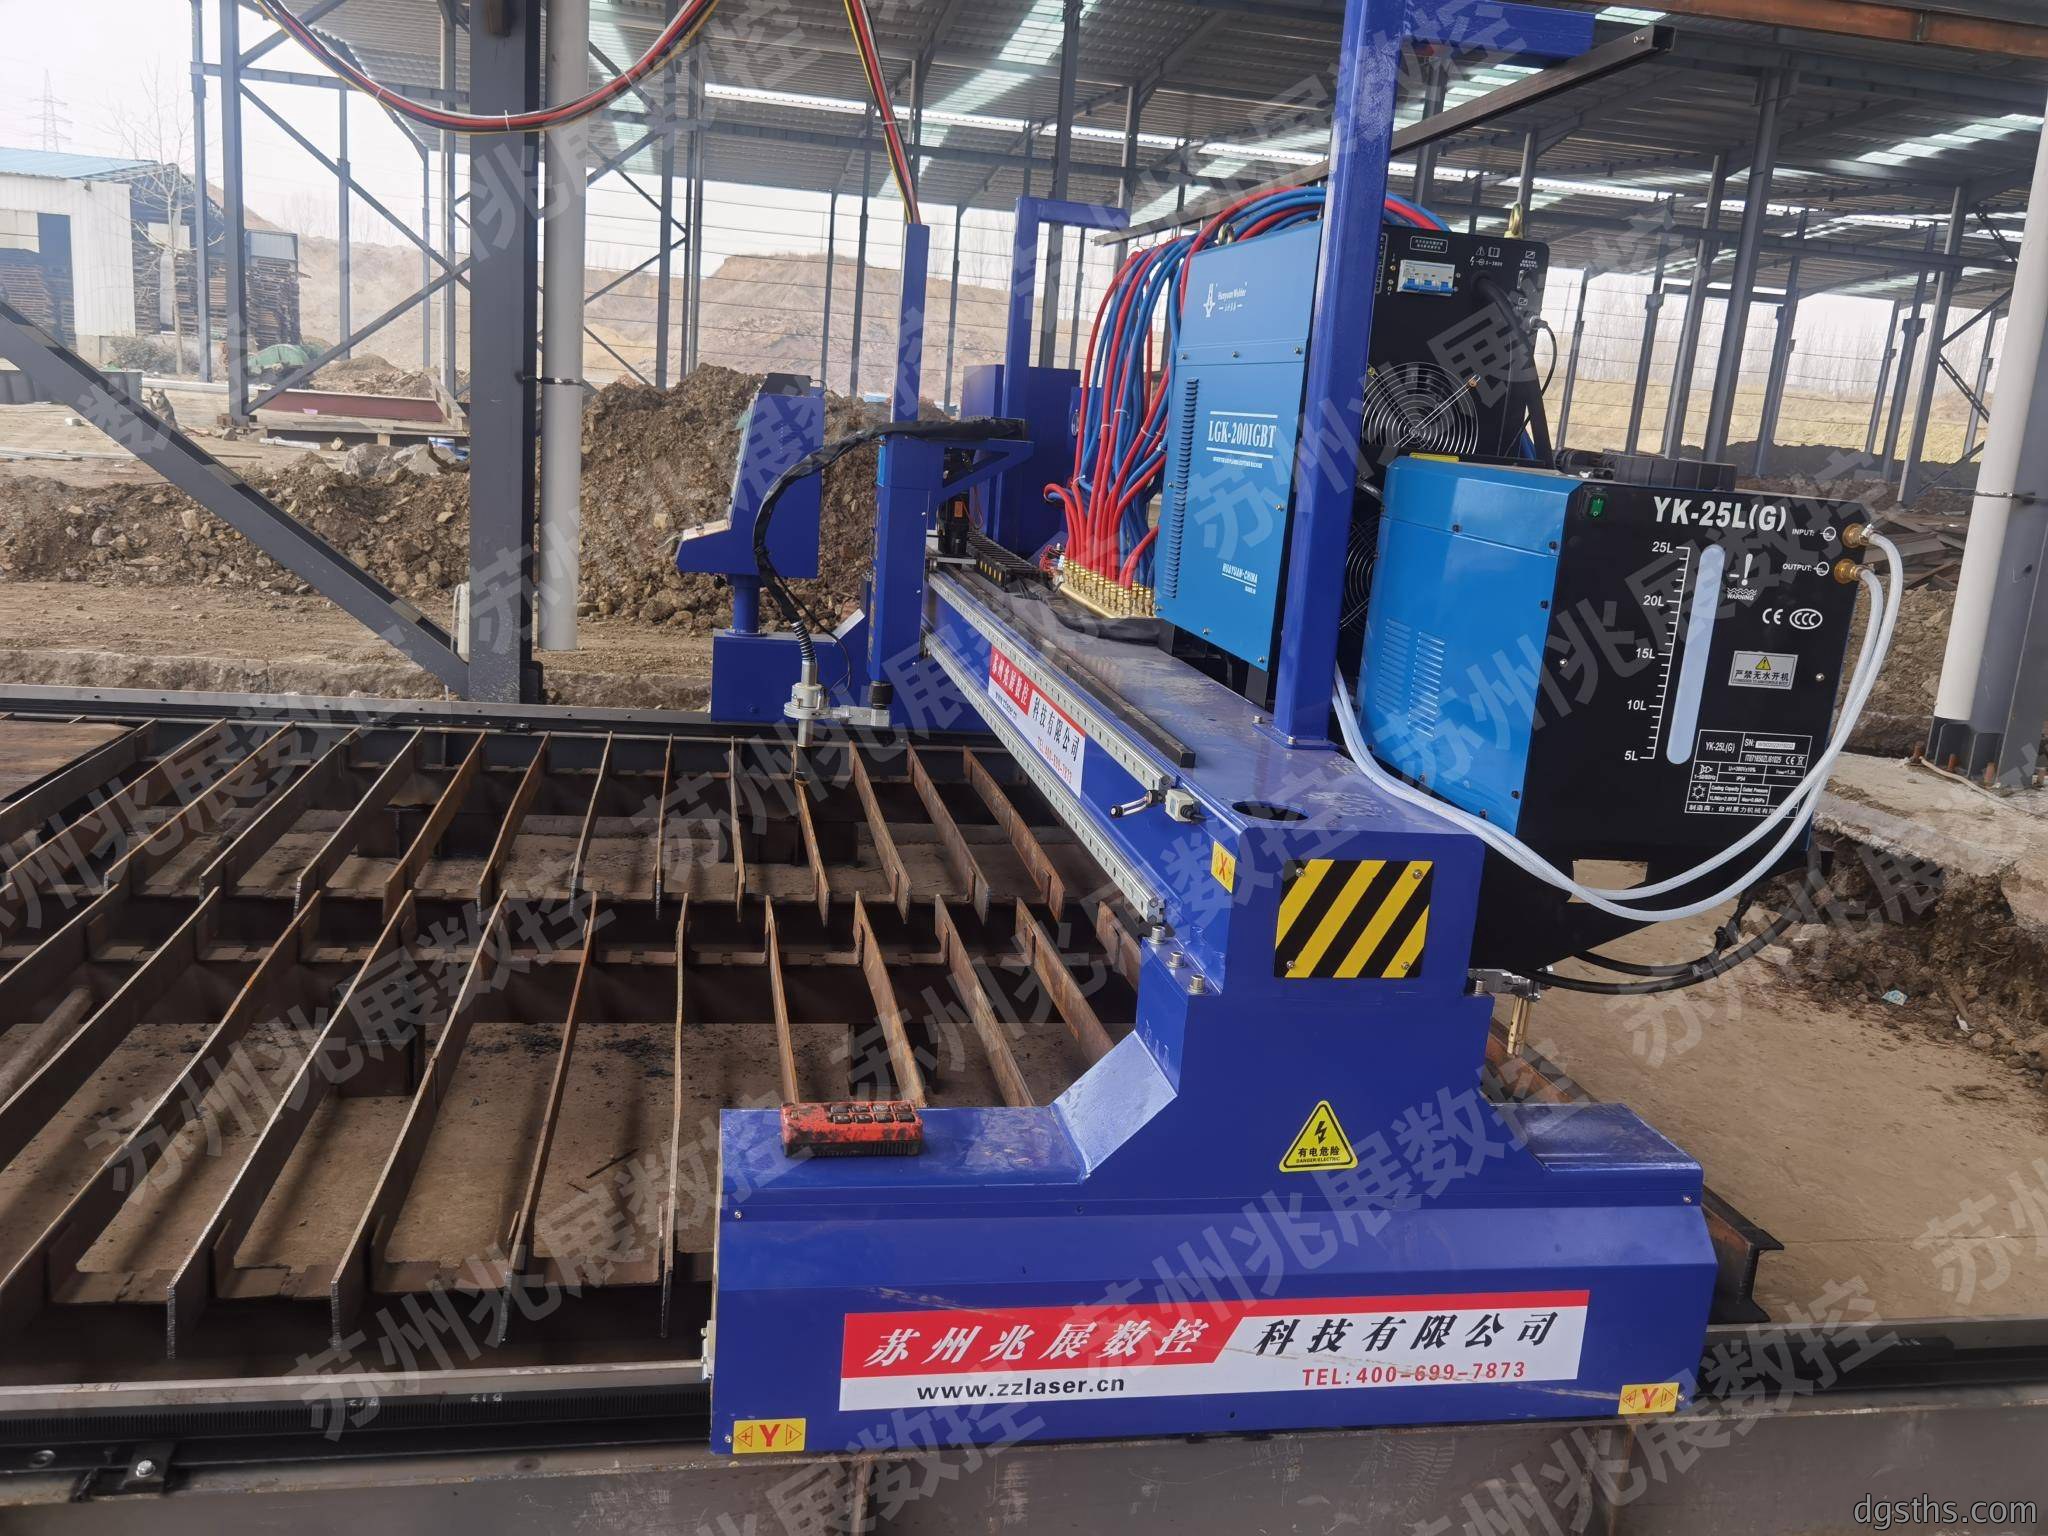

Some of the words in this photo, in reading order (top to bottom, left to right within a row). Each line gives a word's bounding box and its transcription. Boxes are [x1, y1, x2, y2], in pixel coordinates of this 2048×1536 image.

[1208, 420, 1277, 448] LGK-200IGBT
[1654, 496, 1786, 531] YK-25L(G)
[1792, 528, 1815, 537] INPUT:
[1652, 541, 1673, 553] 25L
[1783, 563, 1812, 571] OUTPUT:
[1643, 595, 1664, 606] 20L
[1762, 608, 1783, 624] CE
[1636, 647, 1656, 659] 15L
[1735, 669, 1789, 681] 严禁无水开机
[1627, 700, 1647, 711] 10L
[1705, 741, 1735, 753] YK-25L(G)
[1744, 738, 1755, 747] SN:
[1625, 751, 1639, 761] 5L
[1219, 852, 1227, 880] X
[1298, 1145, 1340, 1157] 有电危险
[864, 1318, 1209, 1368] 苏州兆展数控
[1254, 1311, 1558, 1356] 科技有限公司
[1303, 1361, 1525, 1386] TEL:400-699-7873
[917, 1376, 1125, 1400] www.zzlaser.cn
[1642, 1387, 1659, 1409] Y
[759, 1423, 781, 1448] Y
